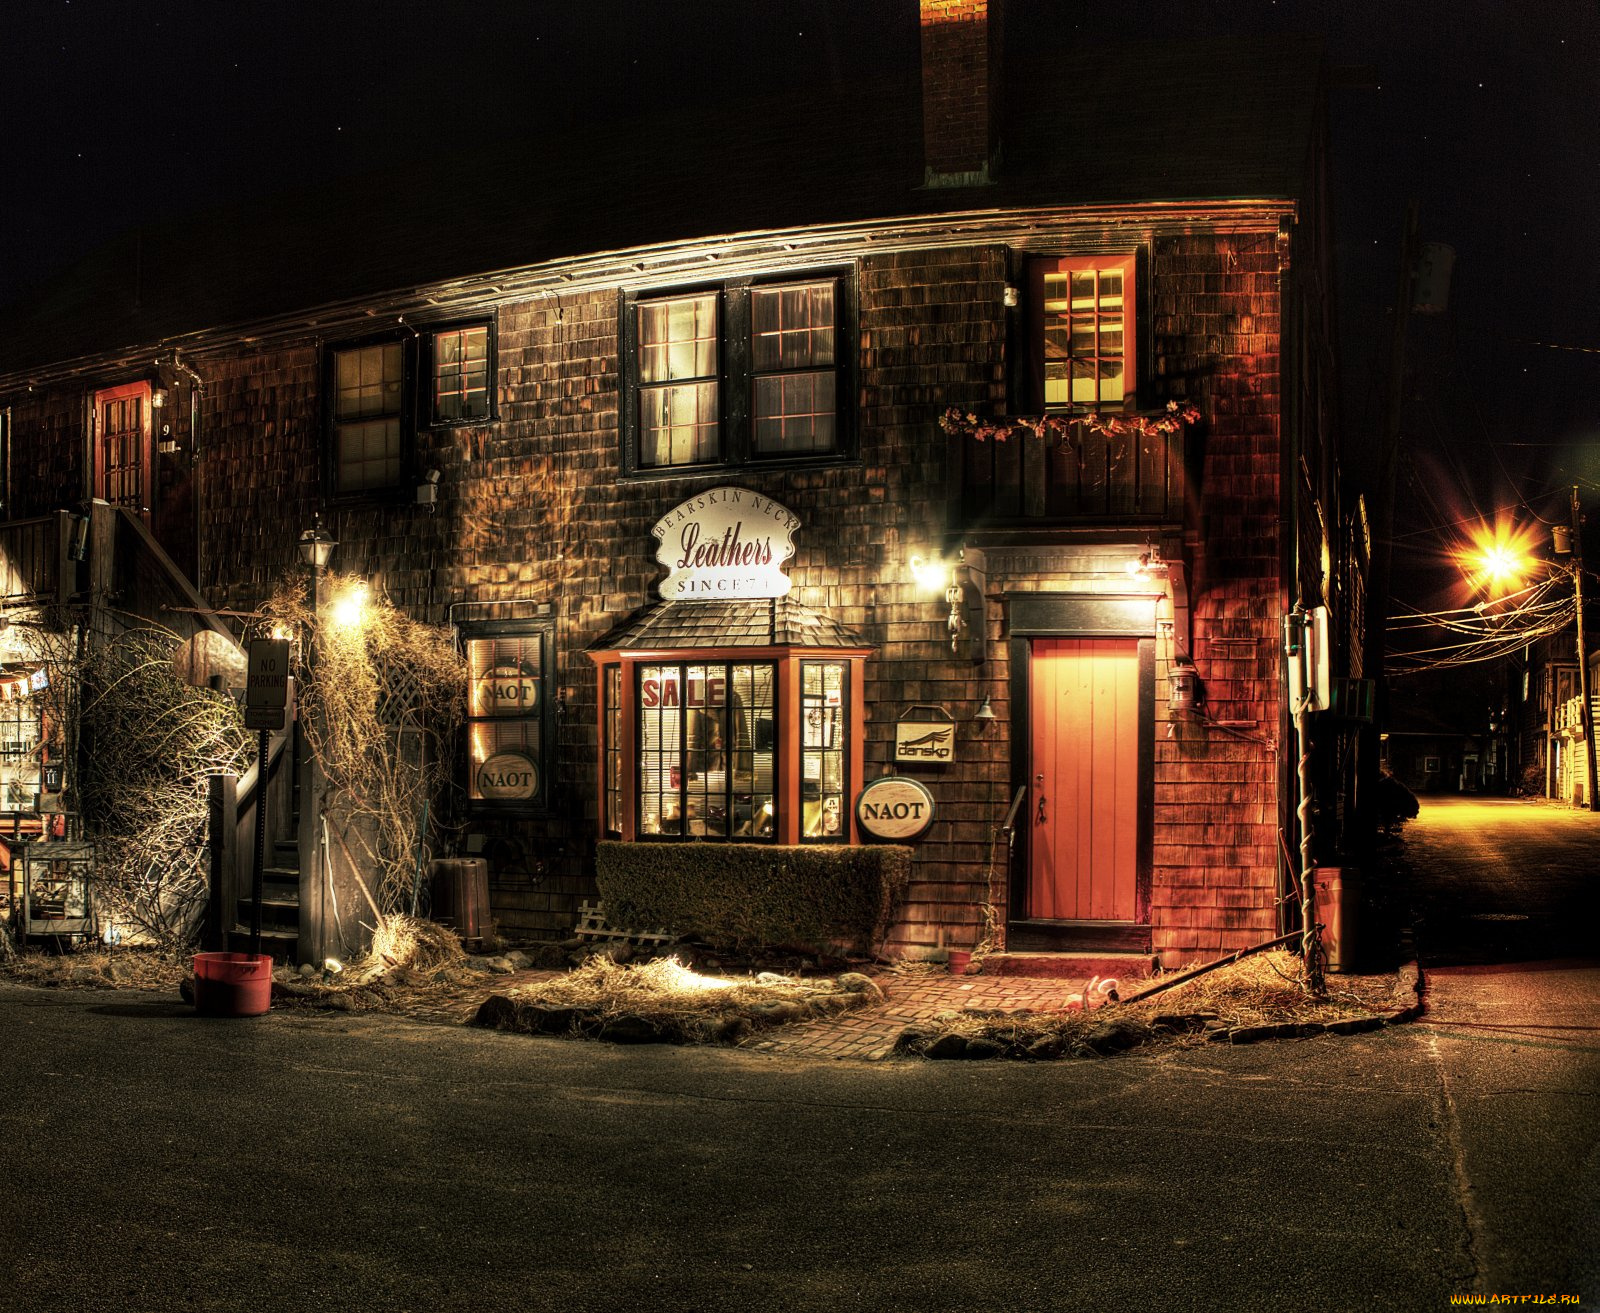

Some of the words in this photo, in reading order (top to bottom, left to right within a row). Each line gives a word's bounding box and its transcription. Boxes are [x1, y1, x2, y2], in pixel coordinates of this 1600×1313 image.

[163, 424, 170, 436] 9
[655, 490, 742, 538] BEARSKIN
[751, 496, 798, 530] NECK
[677, 521, 773, 569] Leathers
[677, 578, 742, 592] SINCE
[261, 658, 276, 672] NO
[250, 674, 285, 688] PARKING
[483, 685, 531, 700] NAOT
[643, 679, 725, 707] SALE
[1167, 723, 1176, 738] 7
[898, 740, 949, 759] dansko
[483, 772, 532, 787] NAOT
[864, 802, 924, 820] NAOT
